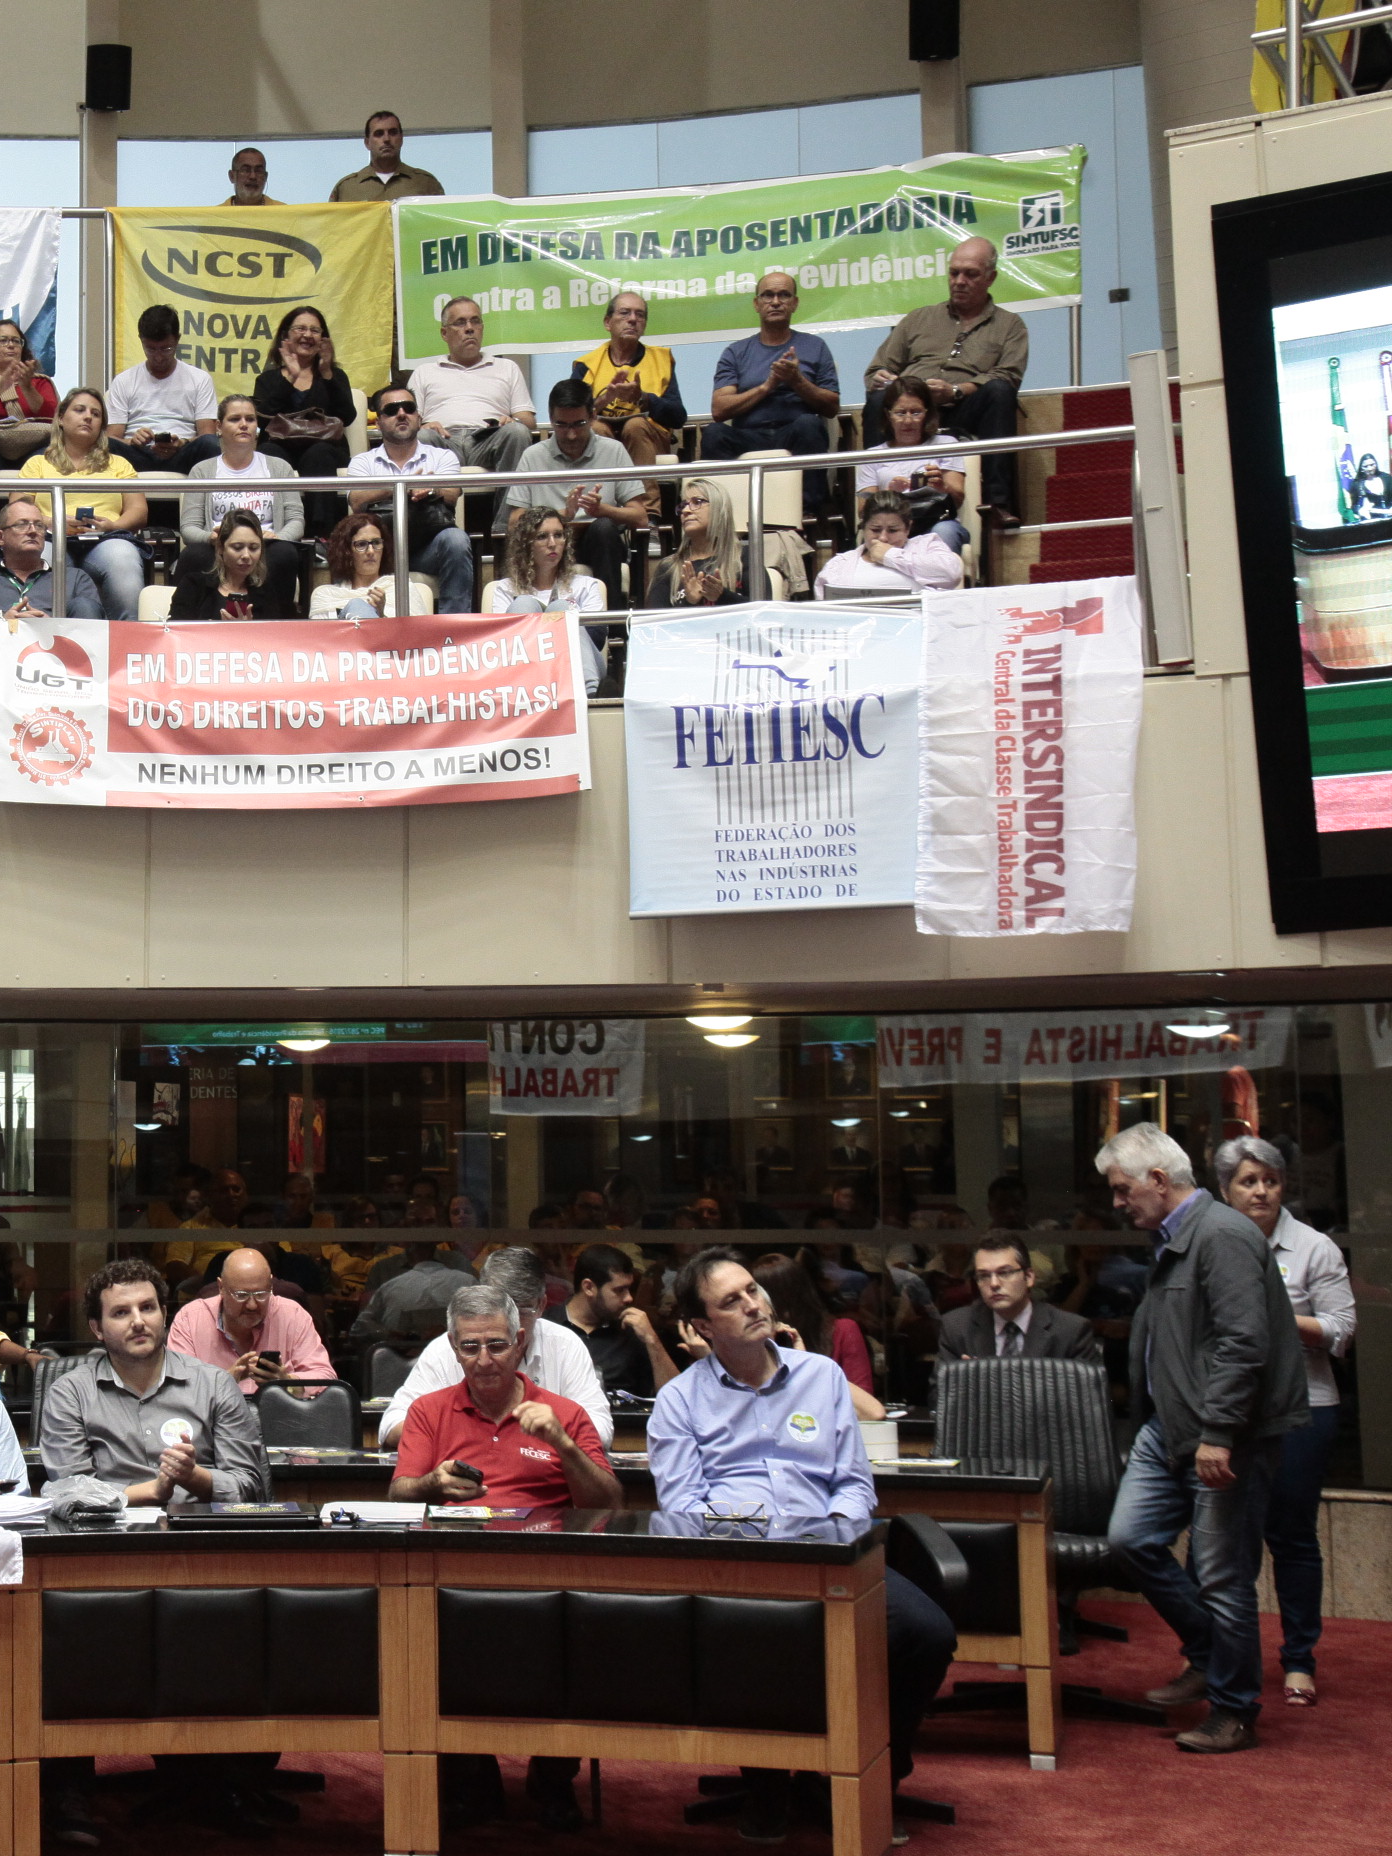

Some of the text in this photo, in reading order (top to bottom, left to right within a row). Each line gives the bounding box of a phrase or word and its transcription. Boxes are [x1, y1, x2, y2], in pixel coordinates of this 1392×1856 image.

[419, 190, 978, 275] EM DEFESA DA APOSENTADORIA
[1005, 226, 1080, 250] SINTUFSC
[167, 247, 294, 279] NCST
[433, 285, 536, 322] Cntra
[542, 286, 562, 310] a
[714, 270, 757, 297] da
[764, 247, 954, 292] revidênci
[183, 309, 274, 340] NOVA
[175, 344, 264, 374] ENTR
[262, 499, 273, 512] FA
[125, 631, 556, 685] EM DEFESA DA PREVIDÊNCIA E
[15, 664, 94, 691] UGT
[127, 681, 559, 730] DOS DIREITOS TRABALHISTAS!
[670, 692, 887, 769] FETIESC
[138, 746, 552, 786] NENHUM DIREITO A MENOS!
[994, 649, 1019, 931] Central da Classe Trabalhadora
[1020, 642, 1067, 930] INTERSINDICAL
[714, 822, 857, 844] FEDERAÇÃO DOS
[715, 843, 858, 863] TRABALHADORES
[716, 862, 859, 884] NAS INDÚSTRIAS
[716, 883, 859, 903] DO ESTADO DE
[188, 1067, 214, 1081] ERIA
[189, 1086, 239, 1099] DENTES
